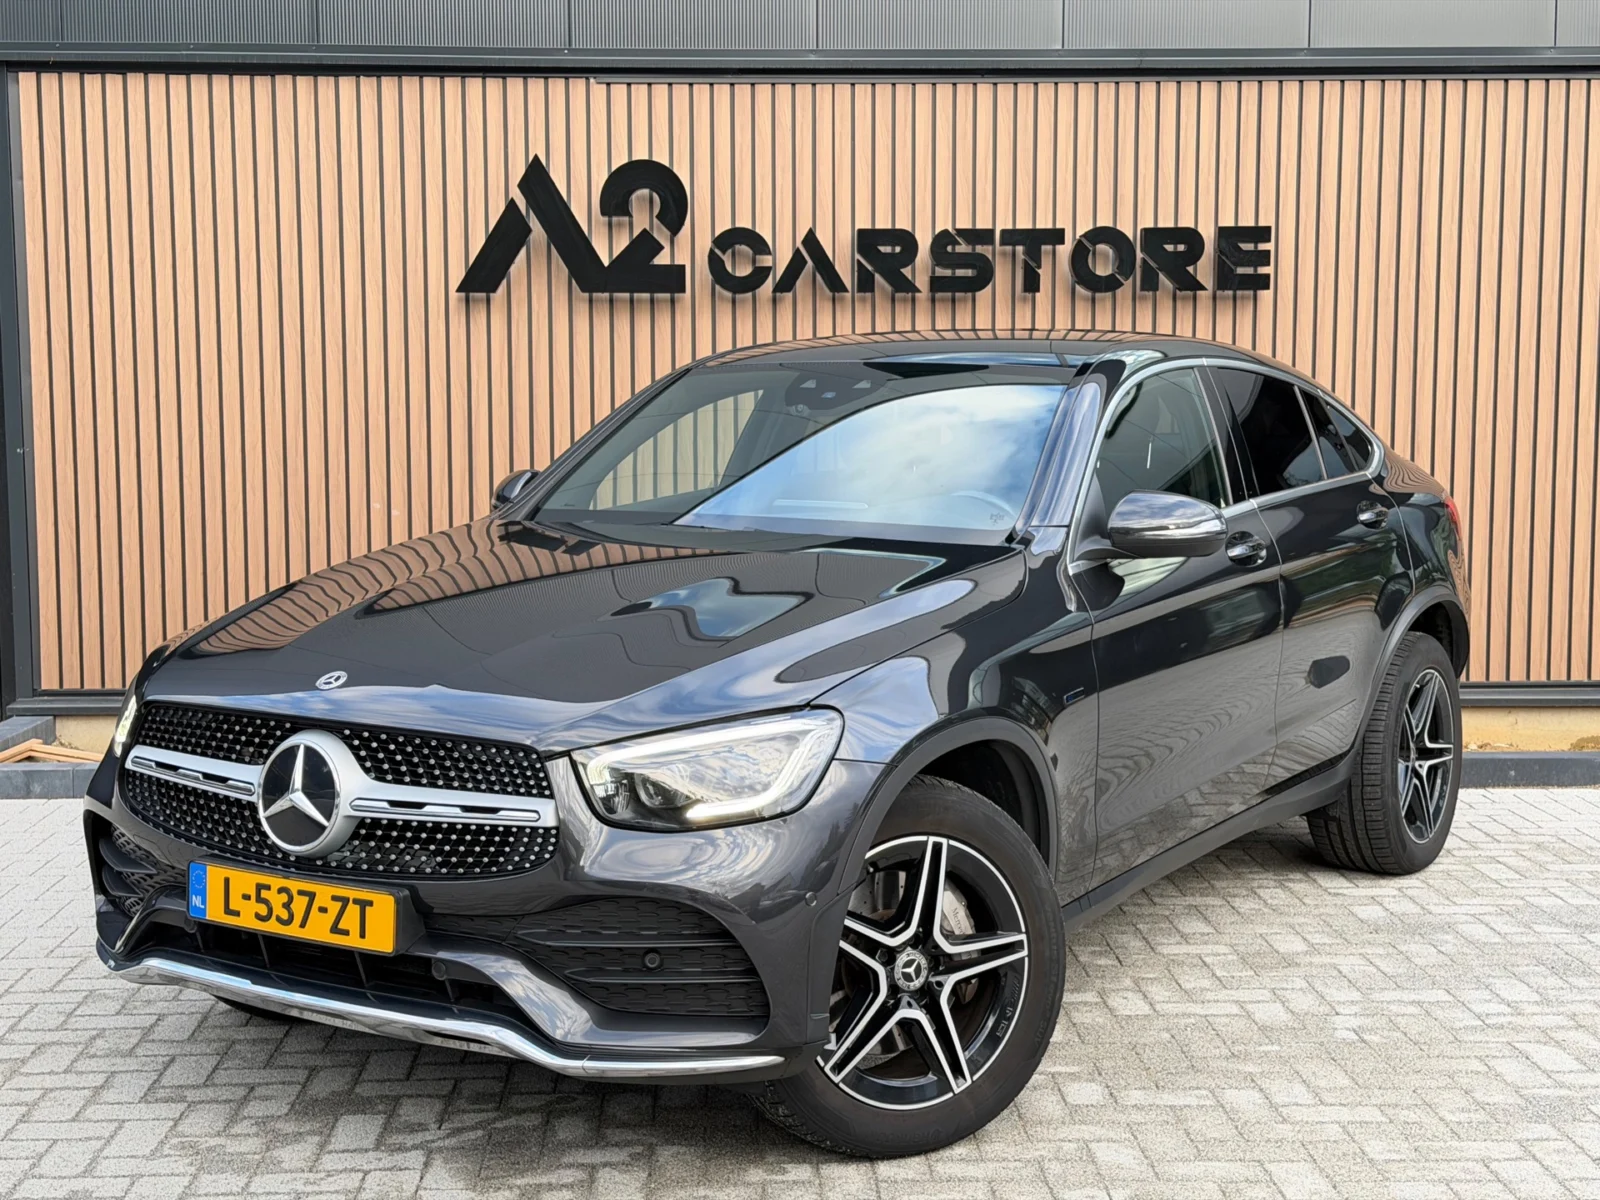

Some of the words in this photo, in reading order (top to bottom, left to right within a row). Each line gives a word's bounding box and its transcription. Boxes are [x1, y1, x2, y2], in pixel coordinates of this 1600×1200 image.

[456, 154, 689, 295] A2
[708, 226, 1272, 295] CARSTORE
[191, 894, 205, 909] NL
[223, 876, 374, 940] L-537-ZT
